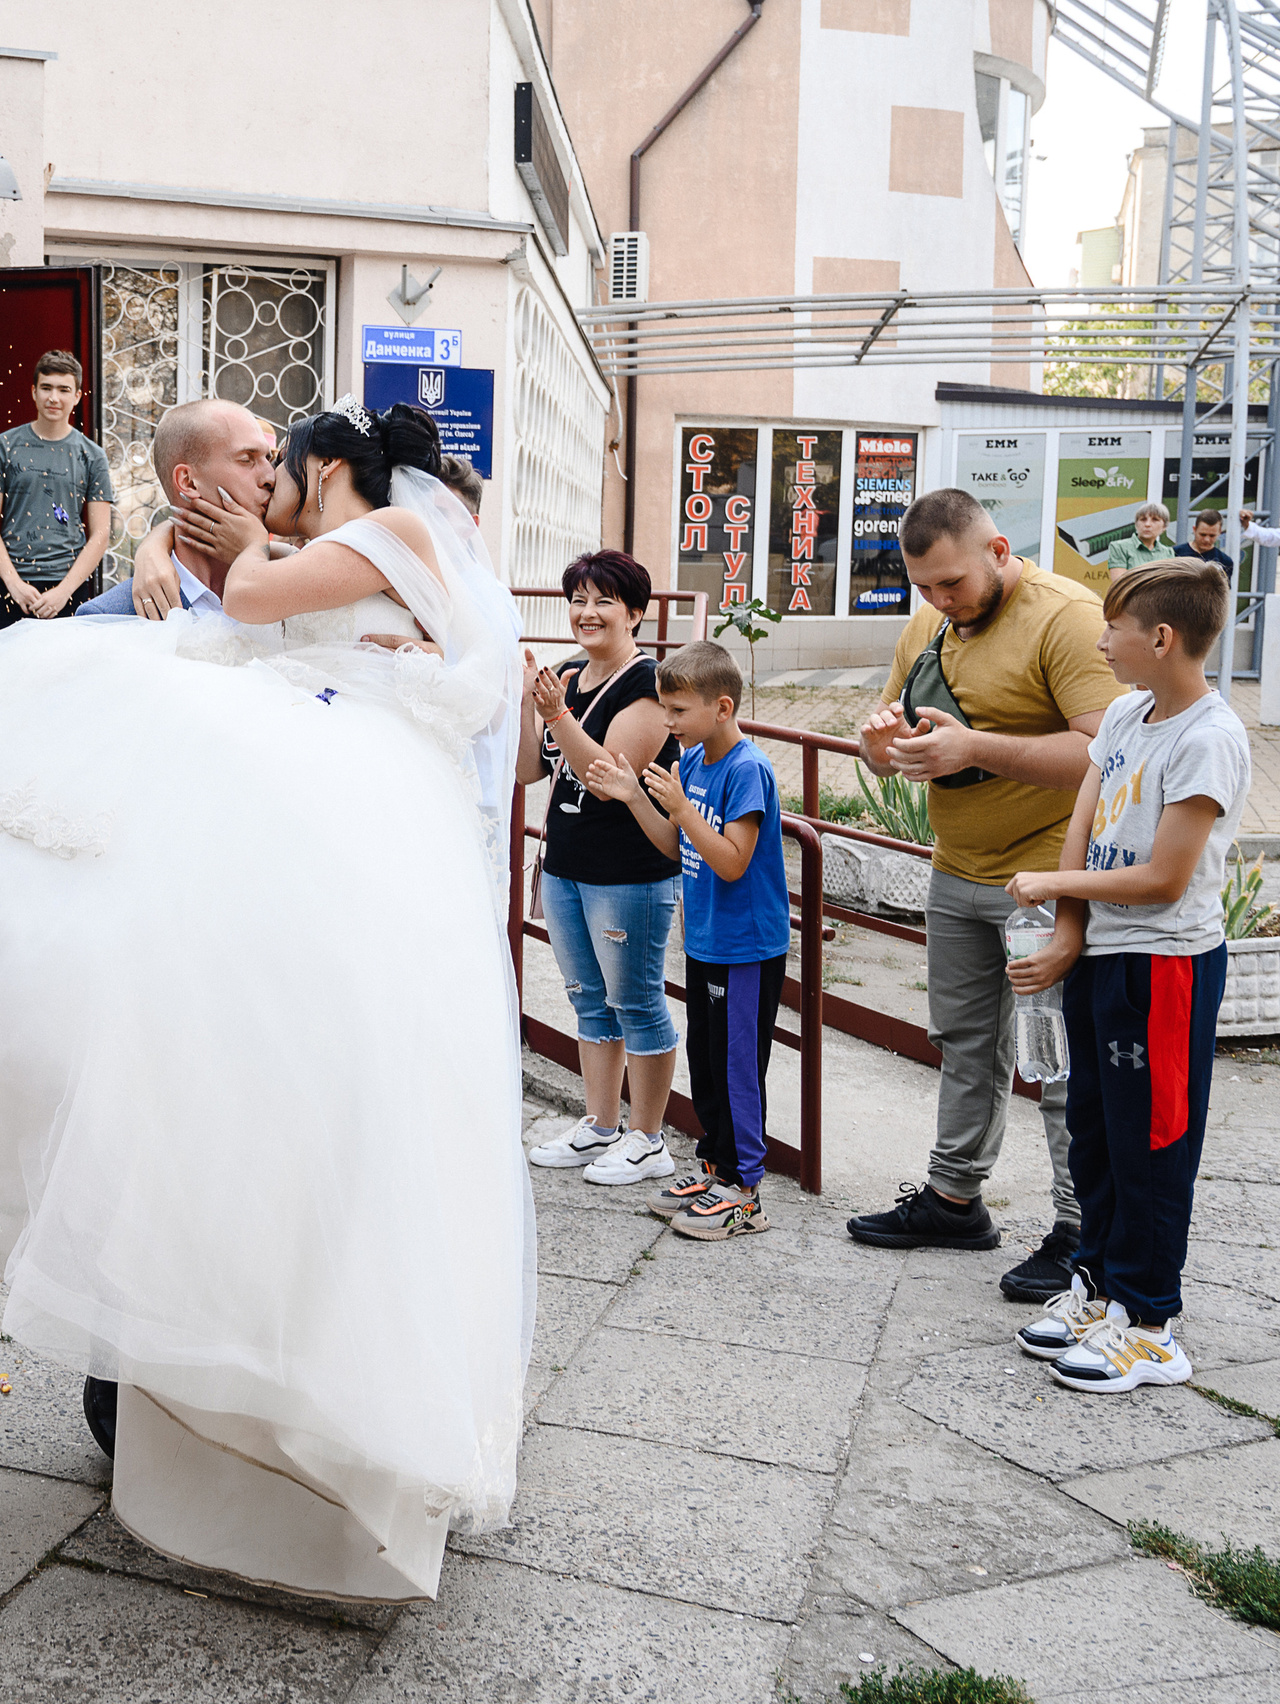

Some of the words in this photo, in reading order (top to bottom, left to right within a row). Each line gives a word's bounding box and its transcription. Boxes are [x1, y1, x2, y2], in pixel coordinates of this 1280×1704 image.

[383, 331, 415, 340] вулиця
[365, 340, 432, 358] Данченка
[859, 439, 912, 454] Miele
[985, 439, 1018, 448] EMM
[1088, 437, 1122, 446] EMM
[1195, 436, 1230, 445] EMM
[868, 456, 912, 468] ARISTON
[858, 467, 897, 479] BOSCH
[971, 472, 998, 481] TAKE
[1009, 472, 1028, 481] GO
[856, 478, 912, 491] SIEMENS
[680, 434, 715, 551] СТОЛ
[875, 490, 912, 507] smeg
[788, 435, 818, 611] ТЕХНИКА
[854, 517, 902, 537] gorenj
[719, 495, 751, 608] СТУЛ
[1084, 571, 1110, 580] ALFA
[859, 592, 902, 603] SAMSUNG
